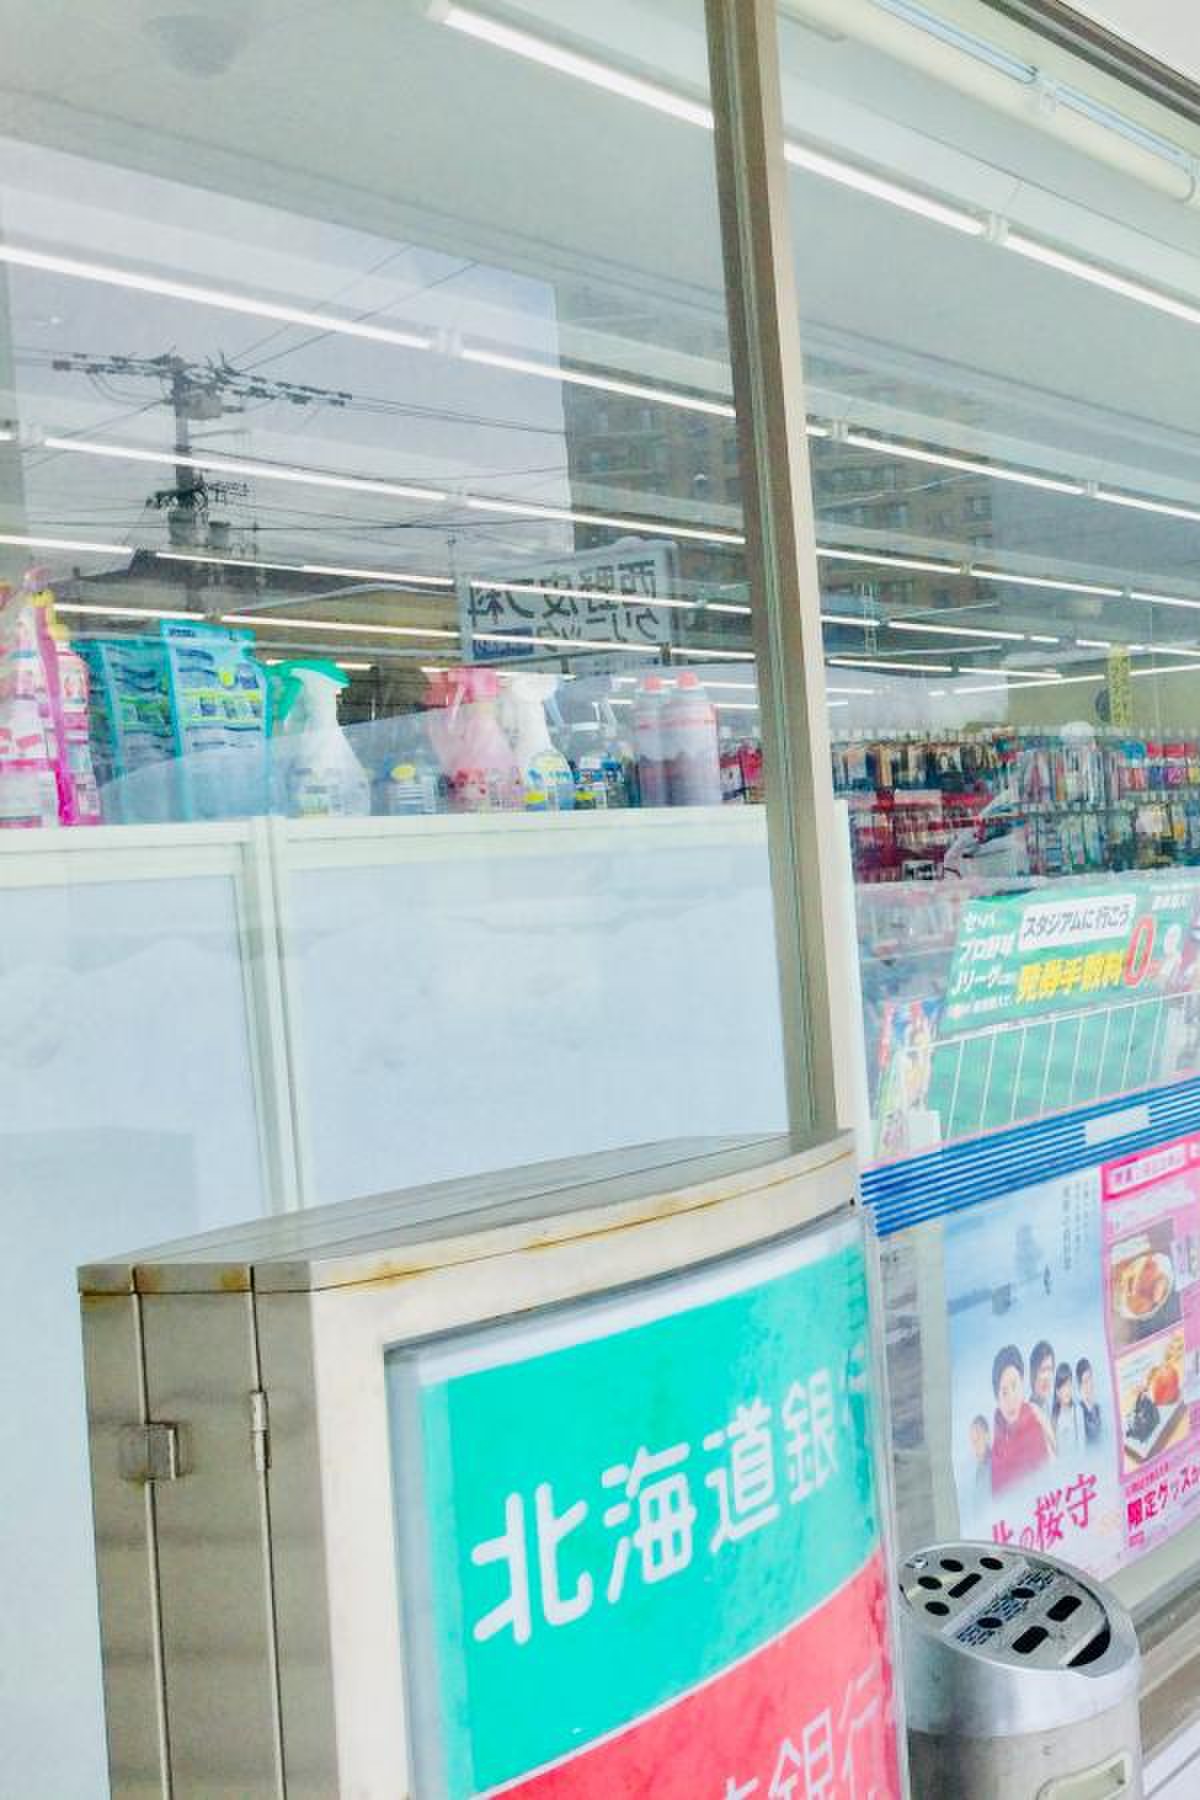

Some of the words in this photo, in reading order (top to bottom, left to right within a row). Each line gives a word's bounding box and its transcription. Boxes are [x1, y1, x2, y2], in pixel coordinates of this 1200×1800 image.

[1022, 903, 1131, 938] スタジアムに行こう
[720, 1657, 883, 1800] 銀行
